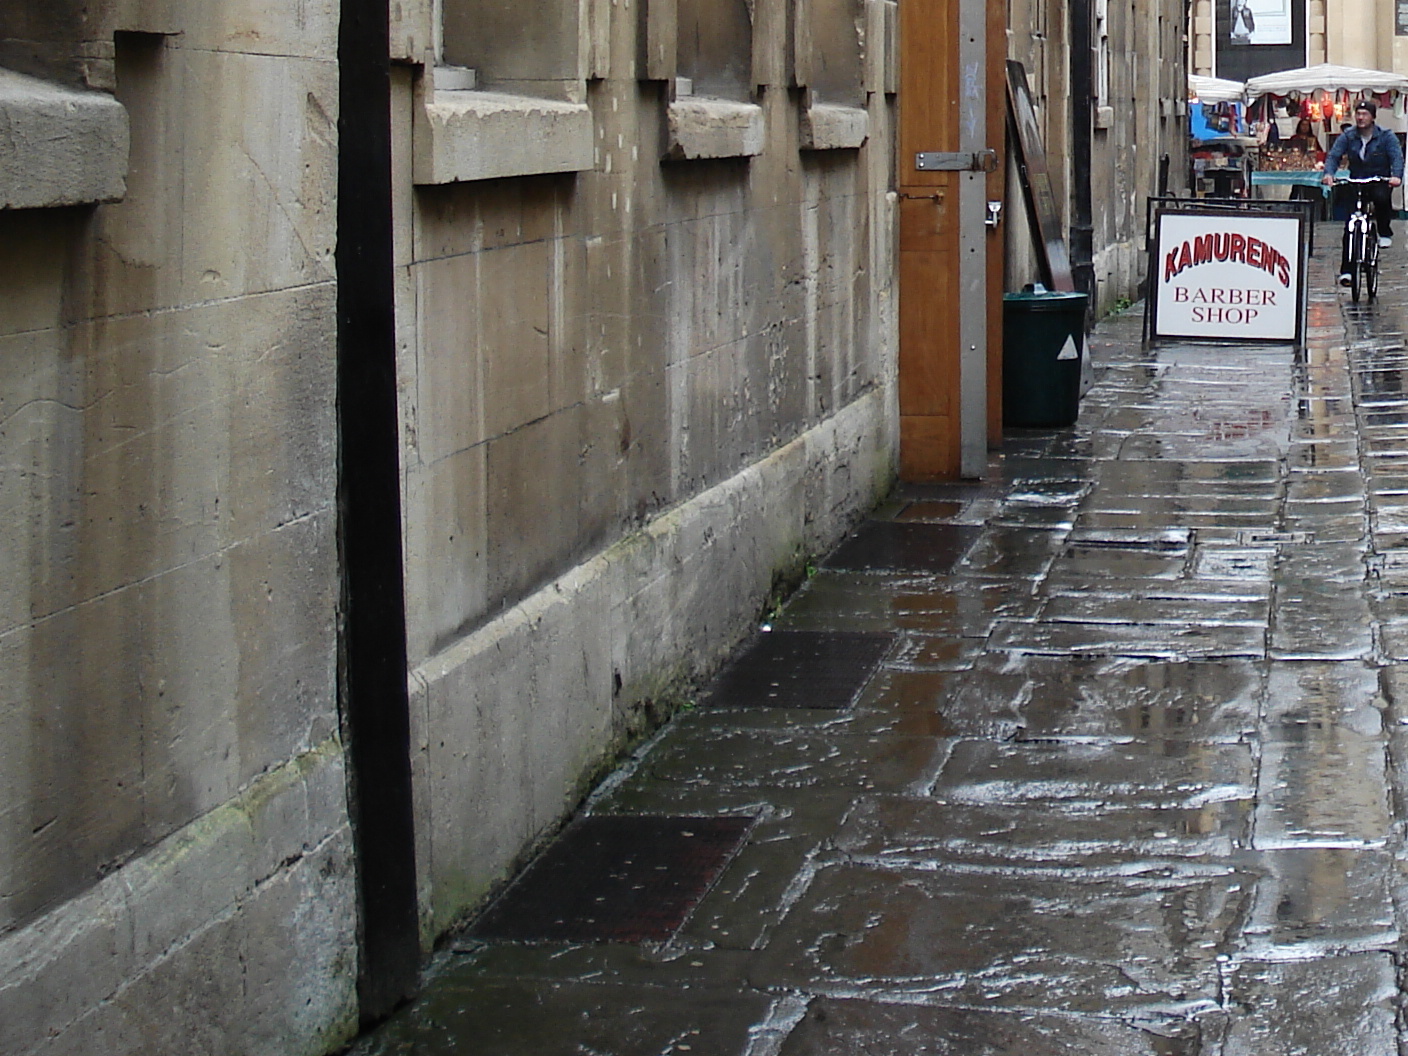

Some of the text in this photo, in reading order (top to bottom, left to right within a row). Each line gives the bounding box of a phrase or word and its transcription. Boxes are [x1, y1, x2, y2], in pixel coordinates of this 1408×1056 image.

[1164, 232, 1291, 288] KAMUREN'S
[1174, 287, 1278, 306] BARBER
[1191, 306, 1259, 324] SHOP
